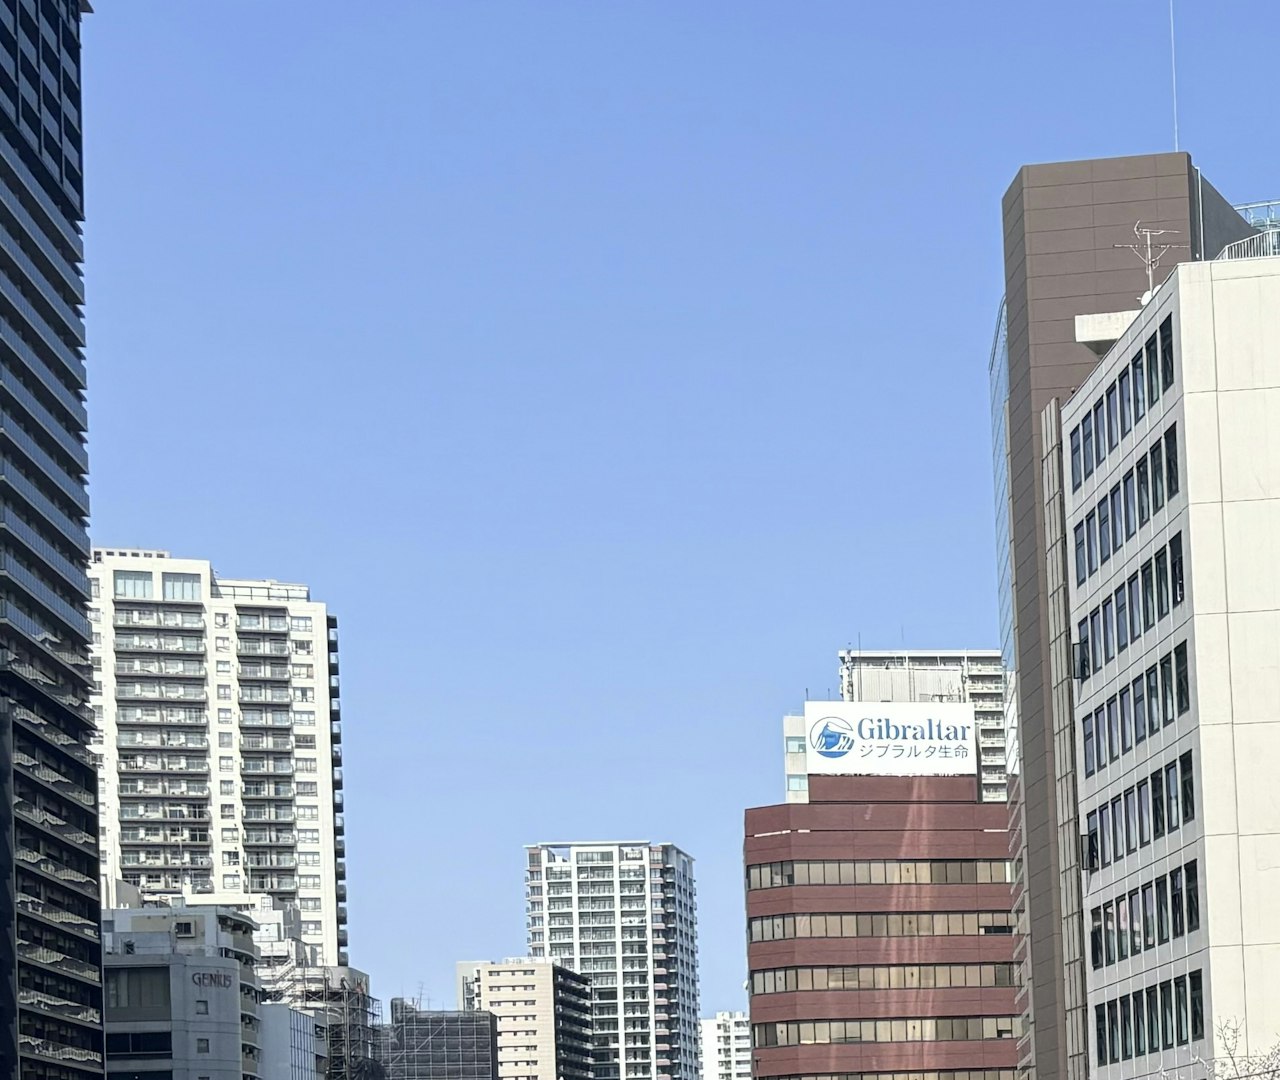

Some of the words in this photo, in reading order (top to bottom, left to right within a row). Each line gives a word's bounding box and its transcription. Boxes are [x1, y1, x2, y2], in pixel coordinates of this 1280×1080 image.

[858, 718, 970, 741] Gibraltar
[859, 744, 969, 759] ジブラルタ生命
